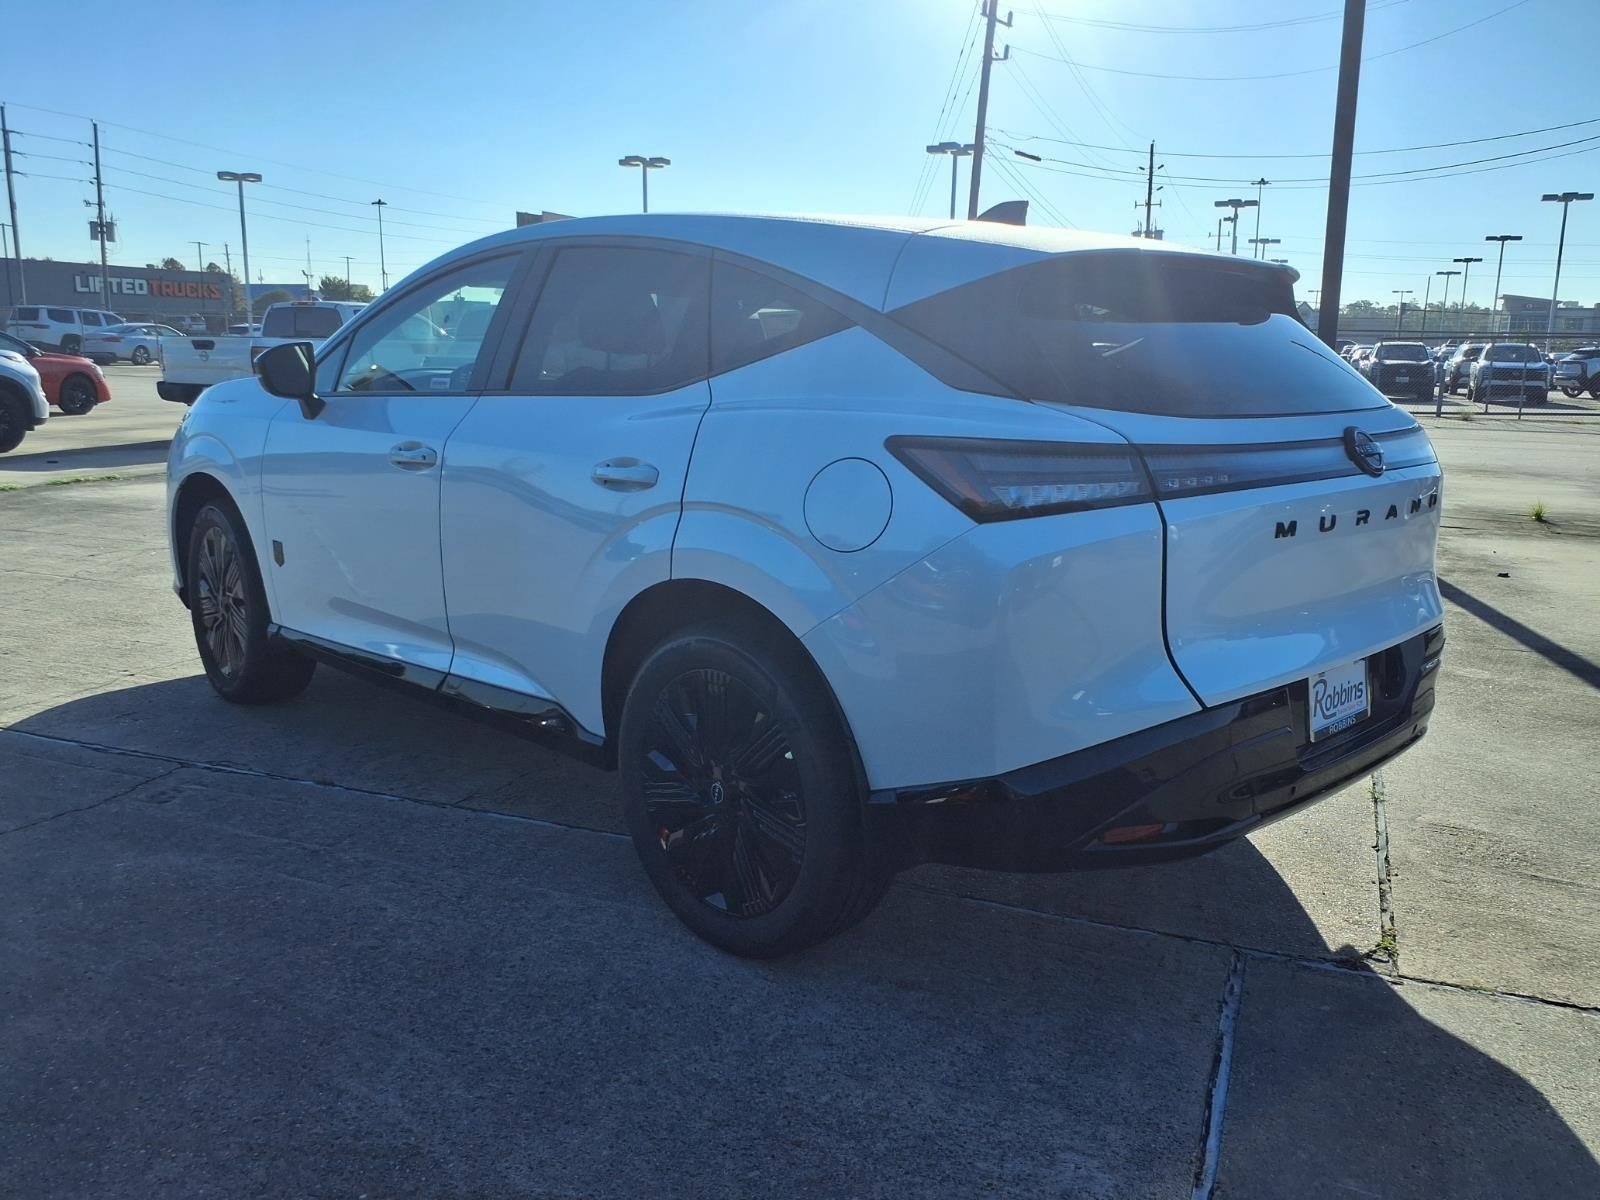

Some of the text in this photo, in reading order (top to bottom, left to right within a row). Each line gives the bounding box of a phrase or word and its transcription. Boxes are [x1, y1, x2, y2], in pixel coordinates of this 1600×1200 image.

[74, 275, 221, 299] LIFTED TRUCKS
[1312, 678, 1364, 720] Robbins
[1329, 714, 1357, 735] ROBBINS
